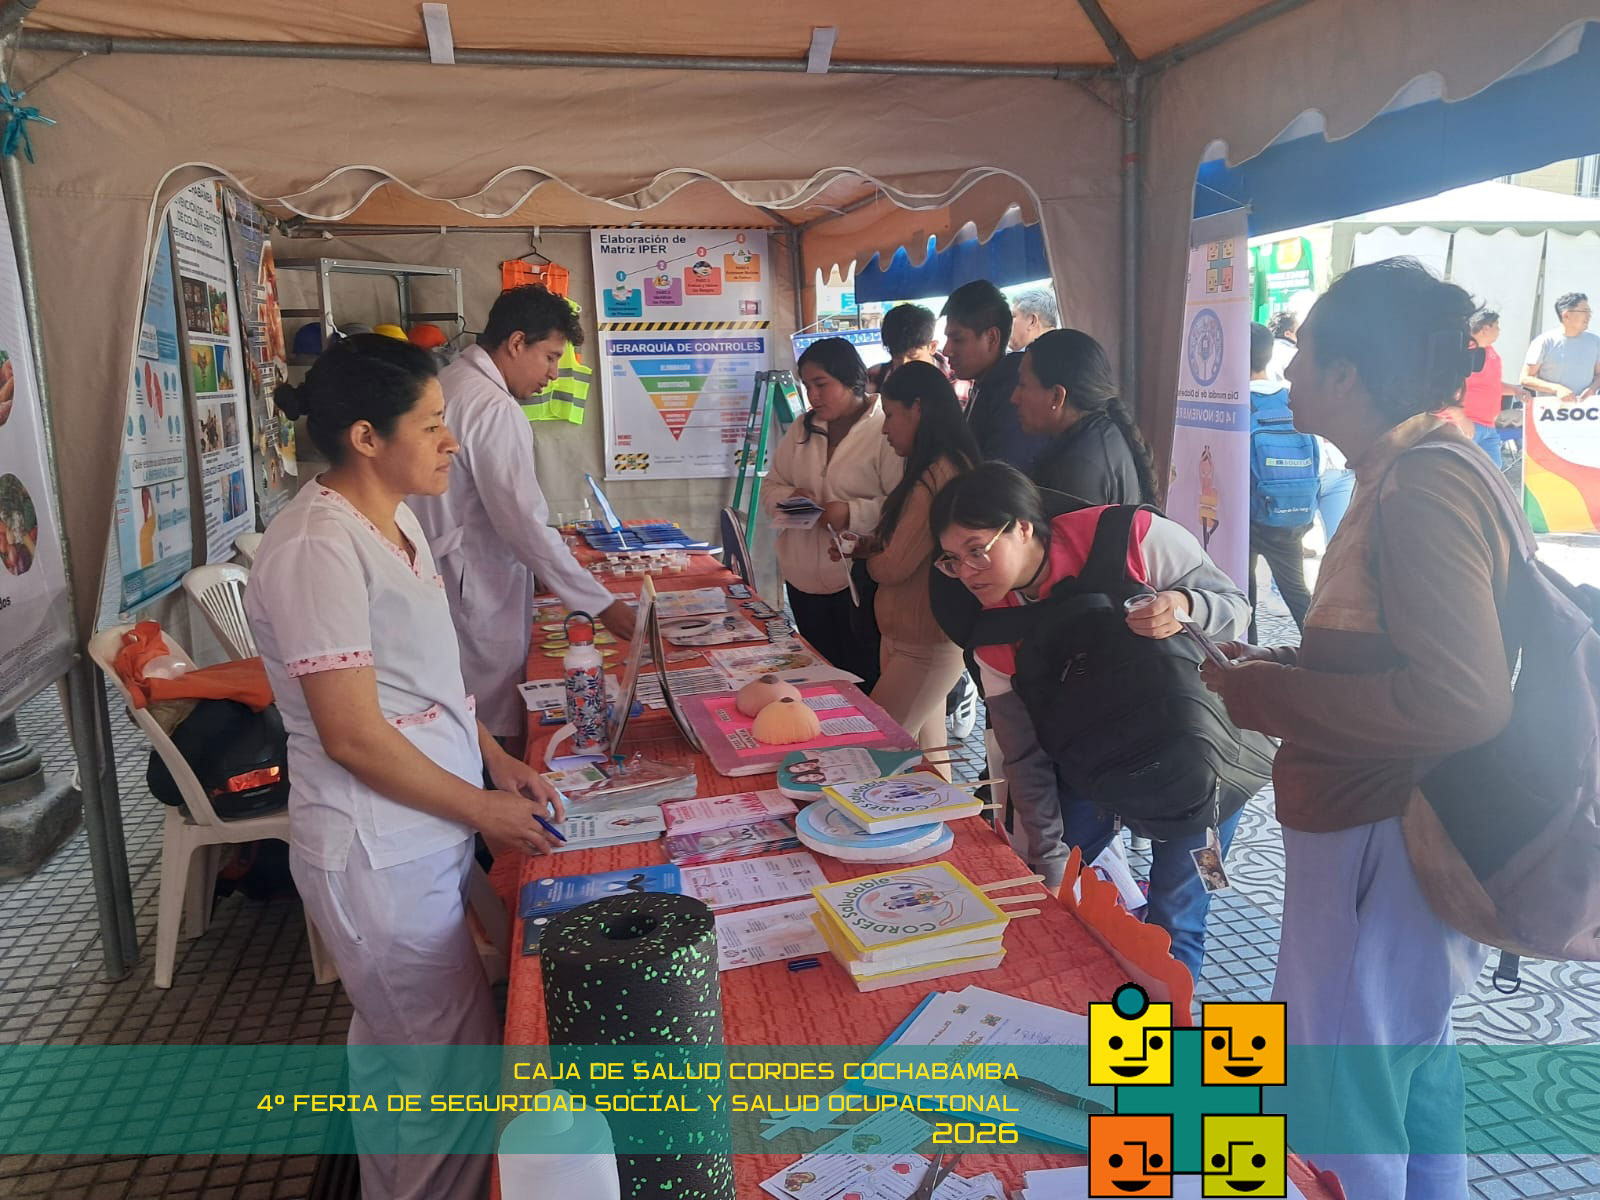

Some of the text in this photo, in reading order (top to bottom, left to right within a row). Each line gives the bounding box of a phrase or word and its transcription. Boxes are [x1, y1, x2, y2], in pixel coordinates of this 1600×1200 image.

[600, 234, 686, 243] Elaboración de
[600, 245, 667, 254] Matriz IPER
[677, 343, 692, 352] DE
[695, 341, 761, 352] CONTROLES
[1540, 407, 1599, 421] ASOC
[861, 803, 929, 812] CORDES
[837, 876, 891, 919] Saludable
[852, 917, 936, 934] CORDES
